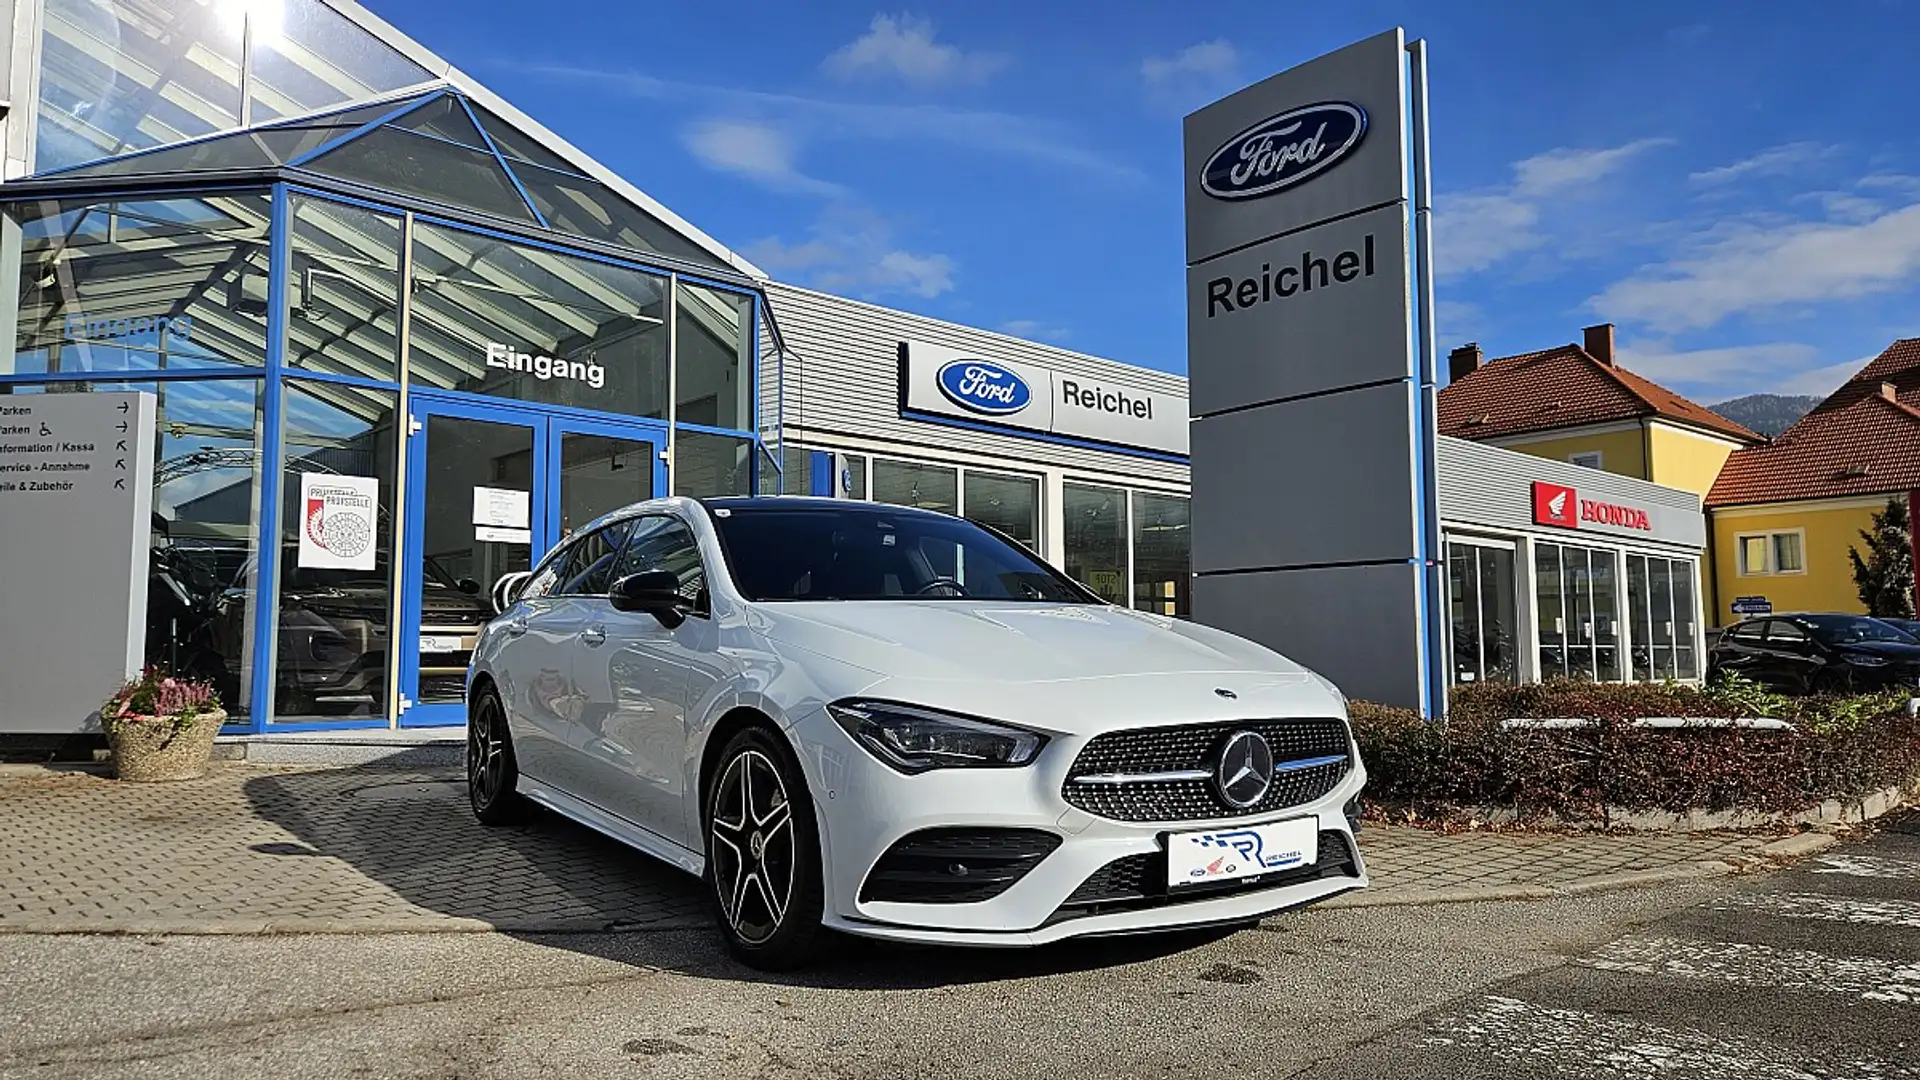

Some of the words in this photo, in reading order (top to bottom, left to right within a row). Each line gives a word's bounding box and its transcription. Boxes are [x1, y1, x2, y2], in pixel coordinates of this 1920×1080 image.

[1230, 120, 1327, 186] Ford
[1207, 233, 1374, 318] Reichel
[64, 312, 192, 341] Eingang
[486, 341, 605, 389] Eingang
[959, 366, 1016, 404] Ford
[1062, 380, 1153, 420] Reichel
[0, 425, 30, 435] arken
[0, 443, 53, 453] formation
[62, 442, 95, 452] Kassa
[0, 461, 31, 472] ervice
[40, 462, 90, 472] Annahme
[19, 482, 27, 491] &
[29, 481, 74, 491] Zubehör
[1581, 499, 1652, 531] HONDA
